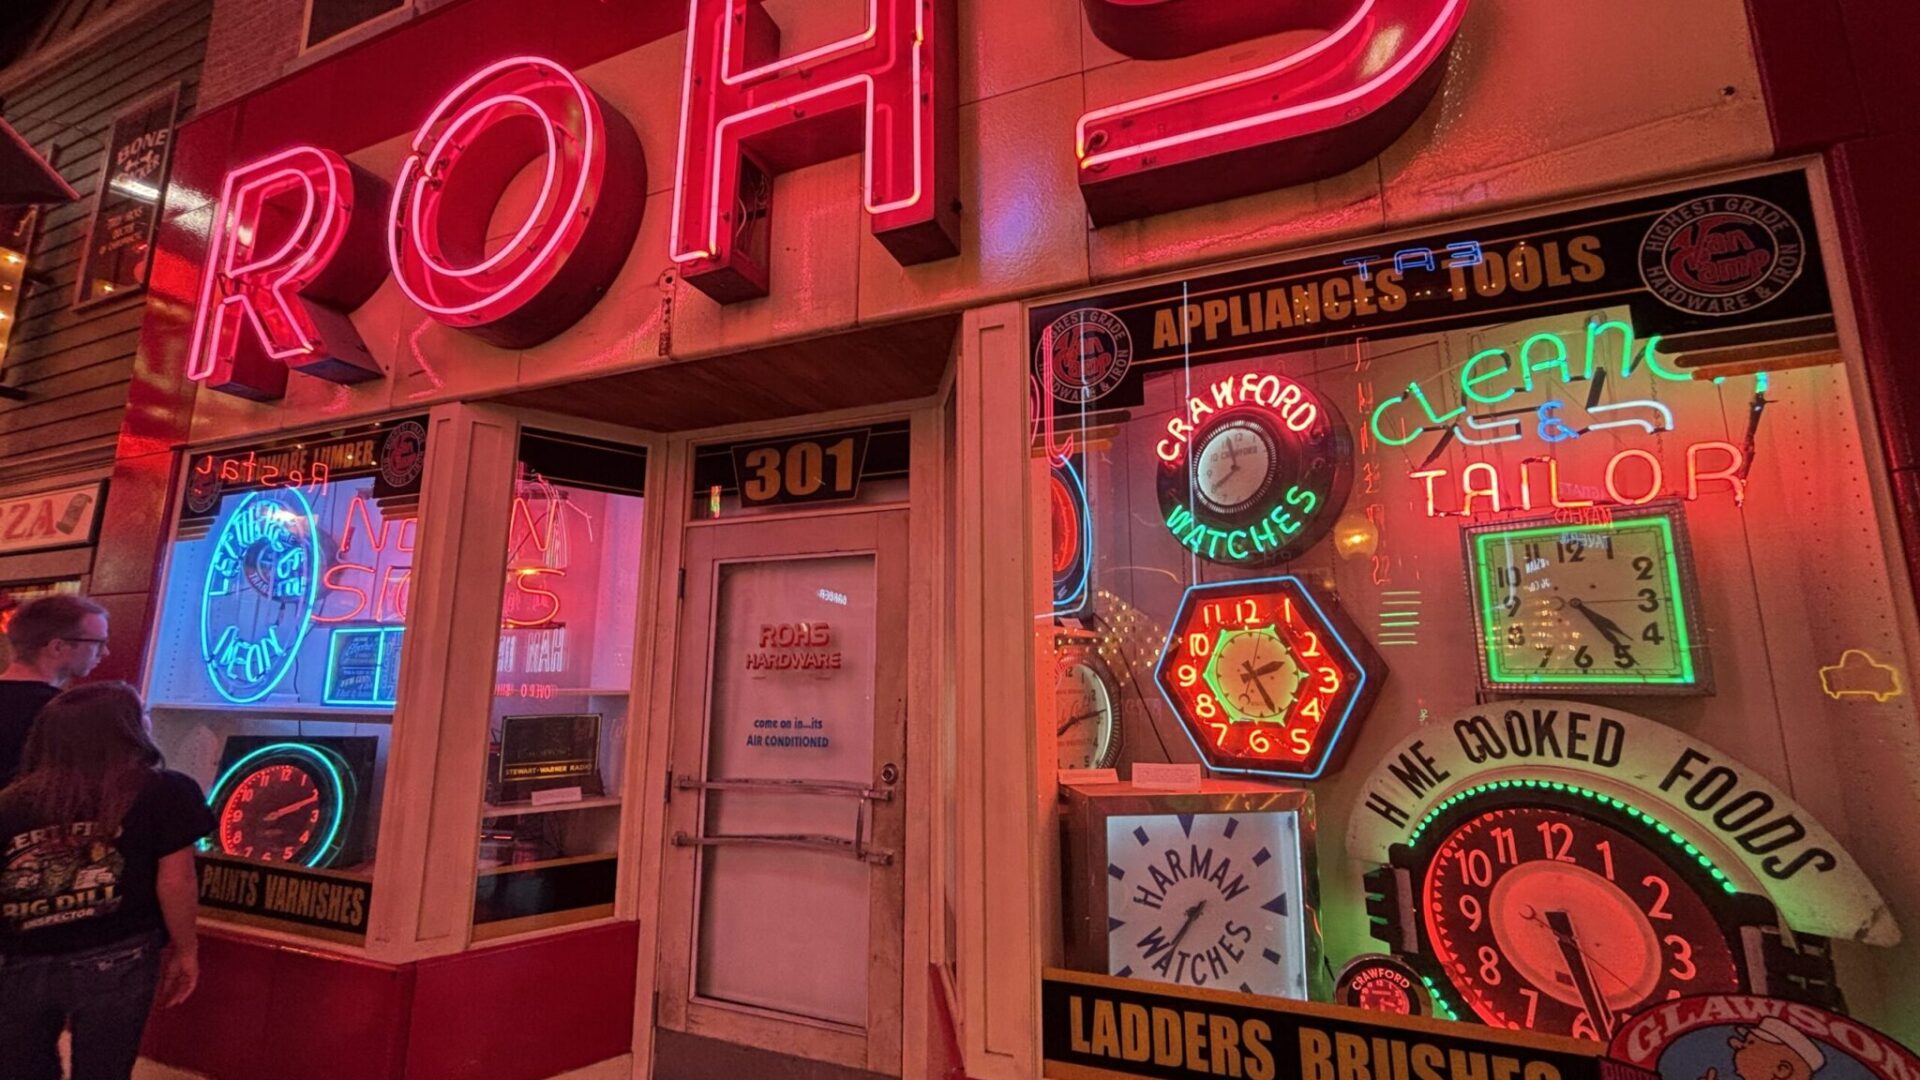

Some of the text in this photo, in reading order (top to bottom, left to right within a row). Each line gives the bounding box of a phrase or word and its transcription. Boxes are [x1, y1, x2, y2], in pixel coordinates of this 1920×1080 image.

[117, 128, 169, 165] BONE
[1645, 197, 1790, 252] HIGHEST GRADE
[1646, 264, 1751, 313] HARDWARE
[1769, 243, 1799, 285] IRON
[1153, 235, 1606, 350] APPLIANCES TOOLS
[1089, 310, 1126, 341] GRADE
[1109, 349, 1129, 381] IRON
[1156, 373, 1318, 461] CRAWFORD
[1537, 400, 1579, 442] &
[313, 440, 375, 472] LUMBER
[744, 437, 855, 501] 301
[1410, 439, 1746, 517] TAILOR
[0, 498, 57, 541] ZA
[1166, 485, 1317, 559] WATCHES
[1524, 543, 1541, 564] 11
[1556, 541, 1586, 563] 12
[1497, 565, 1522, 589] 10
[1631, 556, 1654, 581] 2
[1235, 599, 1261, 624] 12
[1283, 598, 1291, 624] 1
[1503, 595, 1522, 618] 9
[1637, 588, 1660, 613] 3
[1203, 603, 1222, 629] 11
[759, 622, 831, 648] ROHS
[1189, 633, 1210, 657] 10
[1301, 631, 1321, 658] 2
[1507, 625, 1526, 647] 8
[1641, 621, 1665, 646] 4
[746, 652, 842, 670] HARDWARE
[1573, 645, 1594, 669] 6
[1177, 664, 1198, 688] 9
[1317, 666, 1341, 694] 3
[1195, 693, 1217, 719] 8
[1301, 696, 1321, 723] 4
[754, 719, 778, 729] come
[780, 719, 792, 729] on
[1210, 722, 1228, 747] 7
[746, 735, 830, 748] AIR CONDITIONED
[1248, 729, 1270, 754] 6
[1290, 728, 1312, 756] 5
[260, 771, 270, 788] 11
[280, 768, 292, 782] 12
[569, 763, 593, 773] RADIO
[1453, 708, 1626, 768] COOKED
[1658, 746, 1838, 881] FOODS
[233, 810, 244, 824] 9
[310, 809, 320, 823] 3
[233, 830, 243, 845] 8
[299, 830, 310, 845] 4
[1490, 826, 1518, 865] 11
[1536, 821, 1576, 863] 12
[282, 846, 294, 861] 5
[1596, 840, 1615, 881] 1
[1132, 844, 1250, 910] HARMAN
[1454, 848, 1493, 888] 10
[55, 885, 123, 911] DILL
[201, 864, 366, 927] PAINTS VARNISHES
[1641, 875, 1674, 921] 2
[22, 907, 96, 931] INSPECTOR
[1458, 894, 1482, 932] 9
[1136, 920, 1252, 986] WATCHES
[1477, 945, 1502, 986] 8
[1663, 934, 1697, 981] 3
[1351, 967, 1411, 991] CRAWFORD
[1519, 987, 1539, 1029] 7
[1069, 995, 1276, 1080] LADDERS
